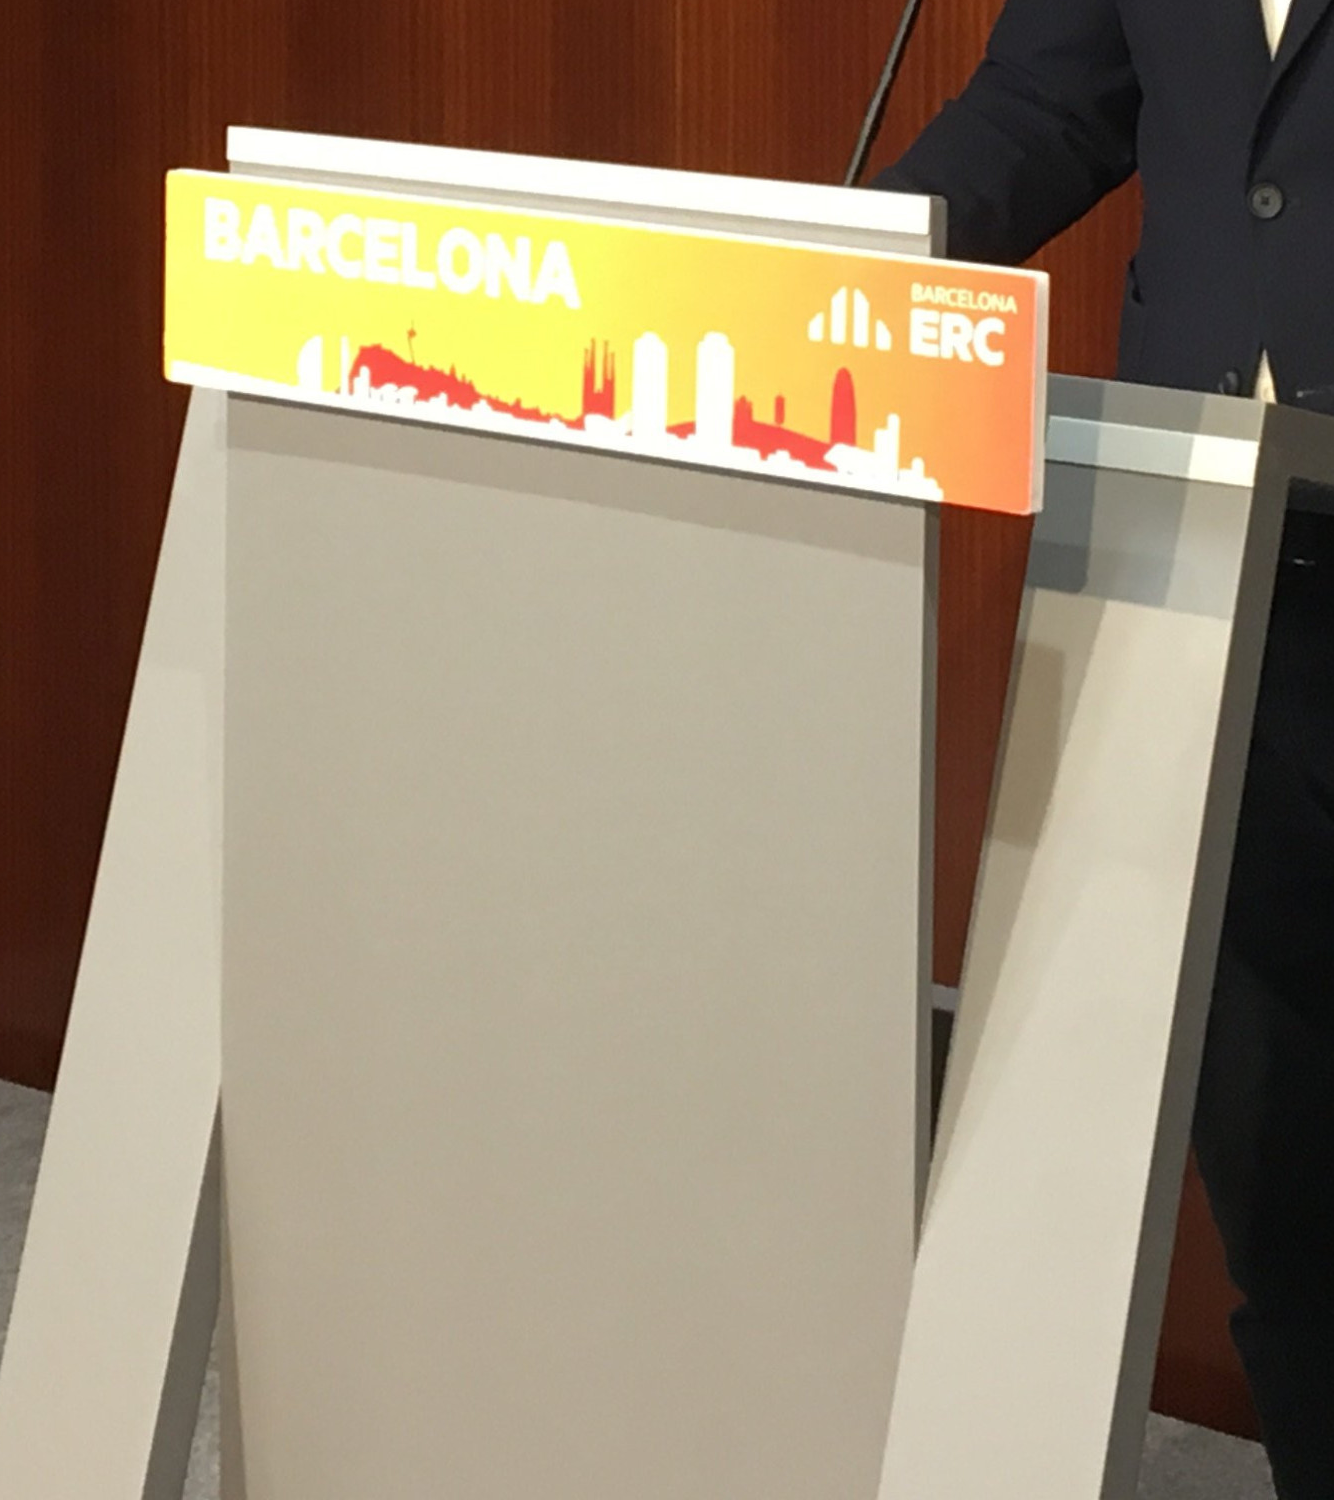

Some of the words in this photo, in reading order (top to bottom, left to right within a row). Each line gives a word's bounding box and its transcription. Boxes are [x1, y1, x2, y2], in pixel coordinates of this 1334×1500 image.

[204, 197, 581, 309] BARCELONA
[911, 282, 1018, 315] BARCELONA
[910, 308, 1005, 367] ERC
